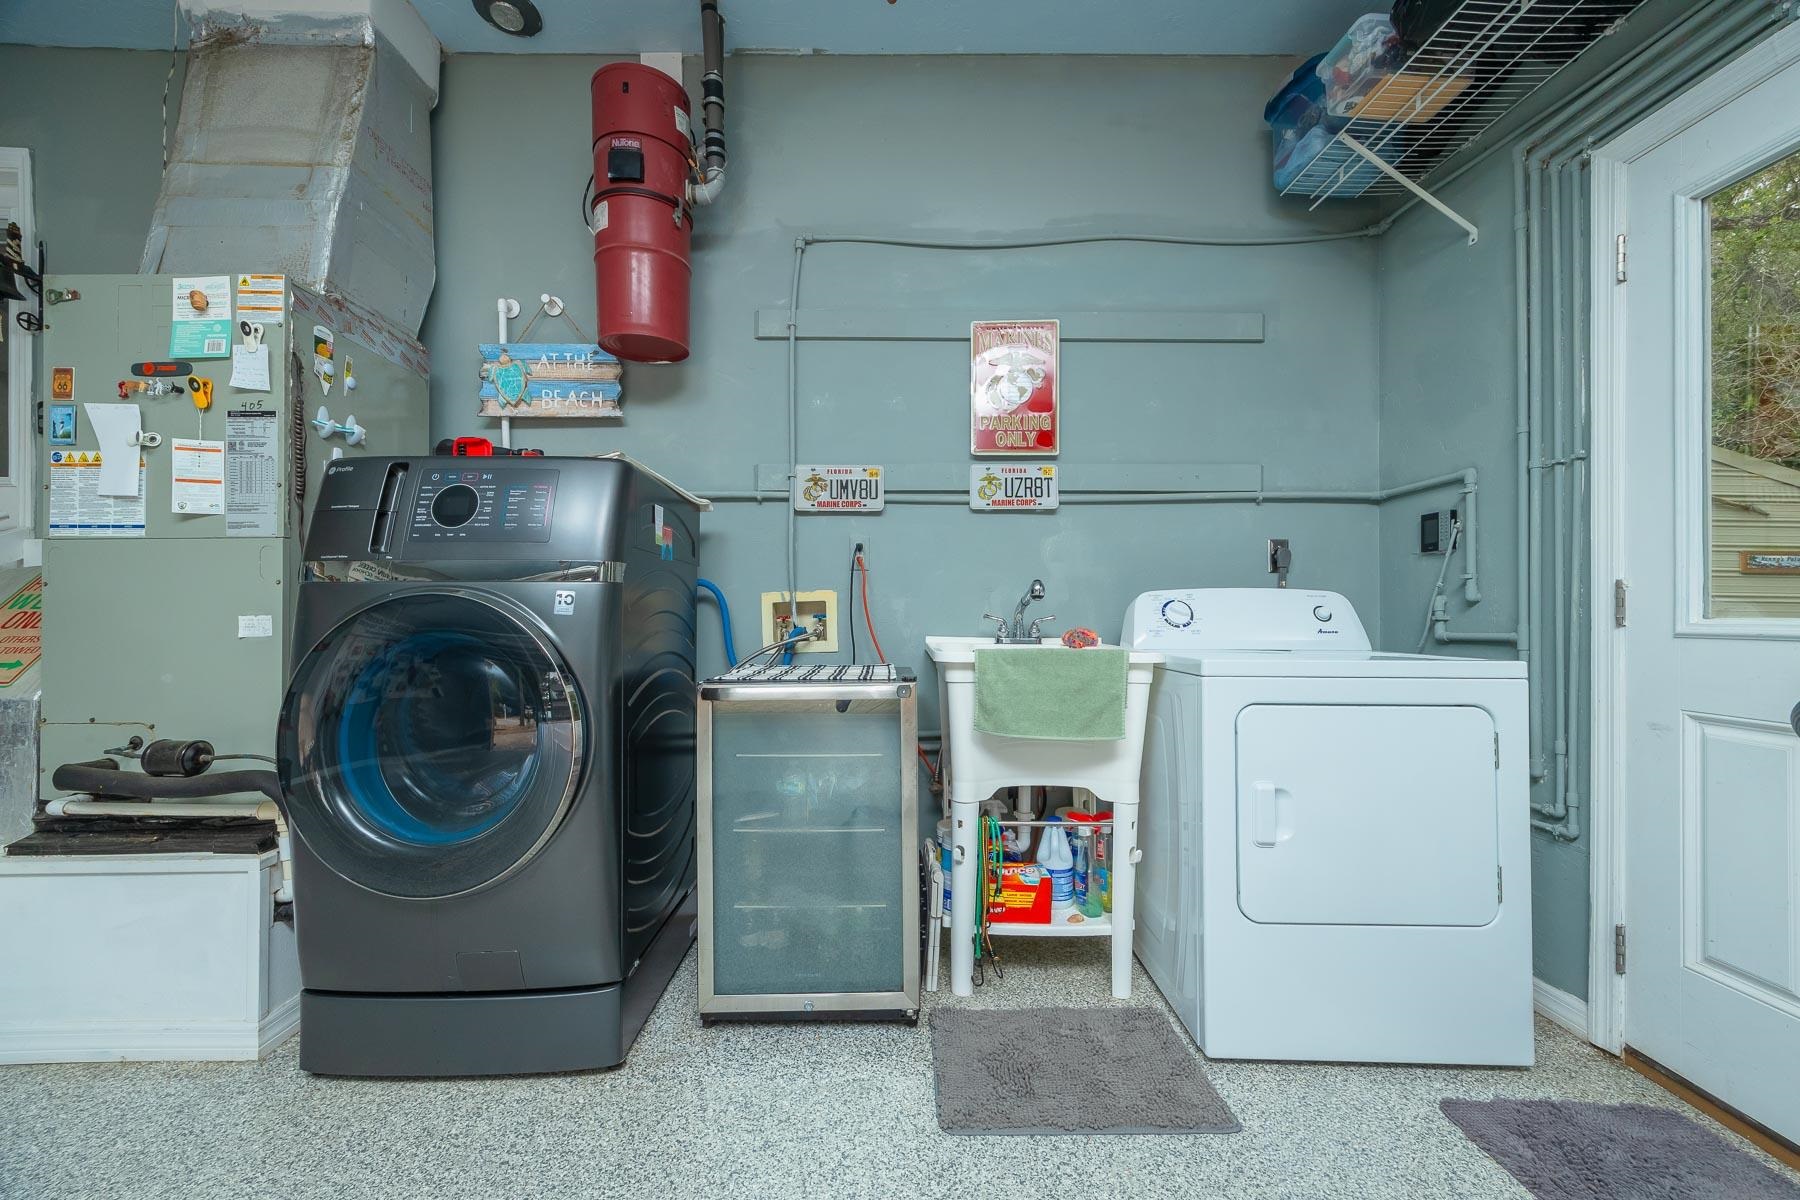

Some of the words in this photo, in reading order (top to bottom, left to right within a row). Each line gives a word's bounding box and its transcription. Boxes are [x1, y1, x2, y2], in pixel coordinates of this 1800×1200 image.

[611, 138, 640, 148] NuTone
[978, 330, 1053, 353] MARINES
[537, 352, 559, 371] AT
[564, 352, 594, 371] THE
[57, 381, 68, 390] 66
[241, 400, 264, 411] 405
[541, 388, 603, 409] BEACH
[979, 414, 1051, 431] PARKING
[995, 430, 1037, 447] ONLY
[1004, 477, 1053, 498] UZR8T
[816, 500, 840, 508] MARINE
[841, 500, 862, 508] CORPS
[991, 498, 1014, 507] MARINE
[1015, 498, 1037, 506] CORPS
